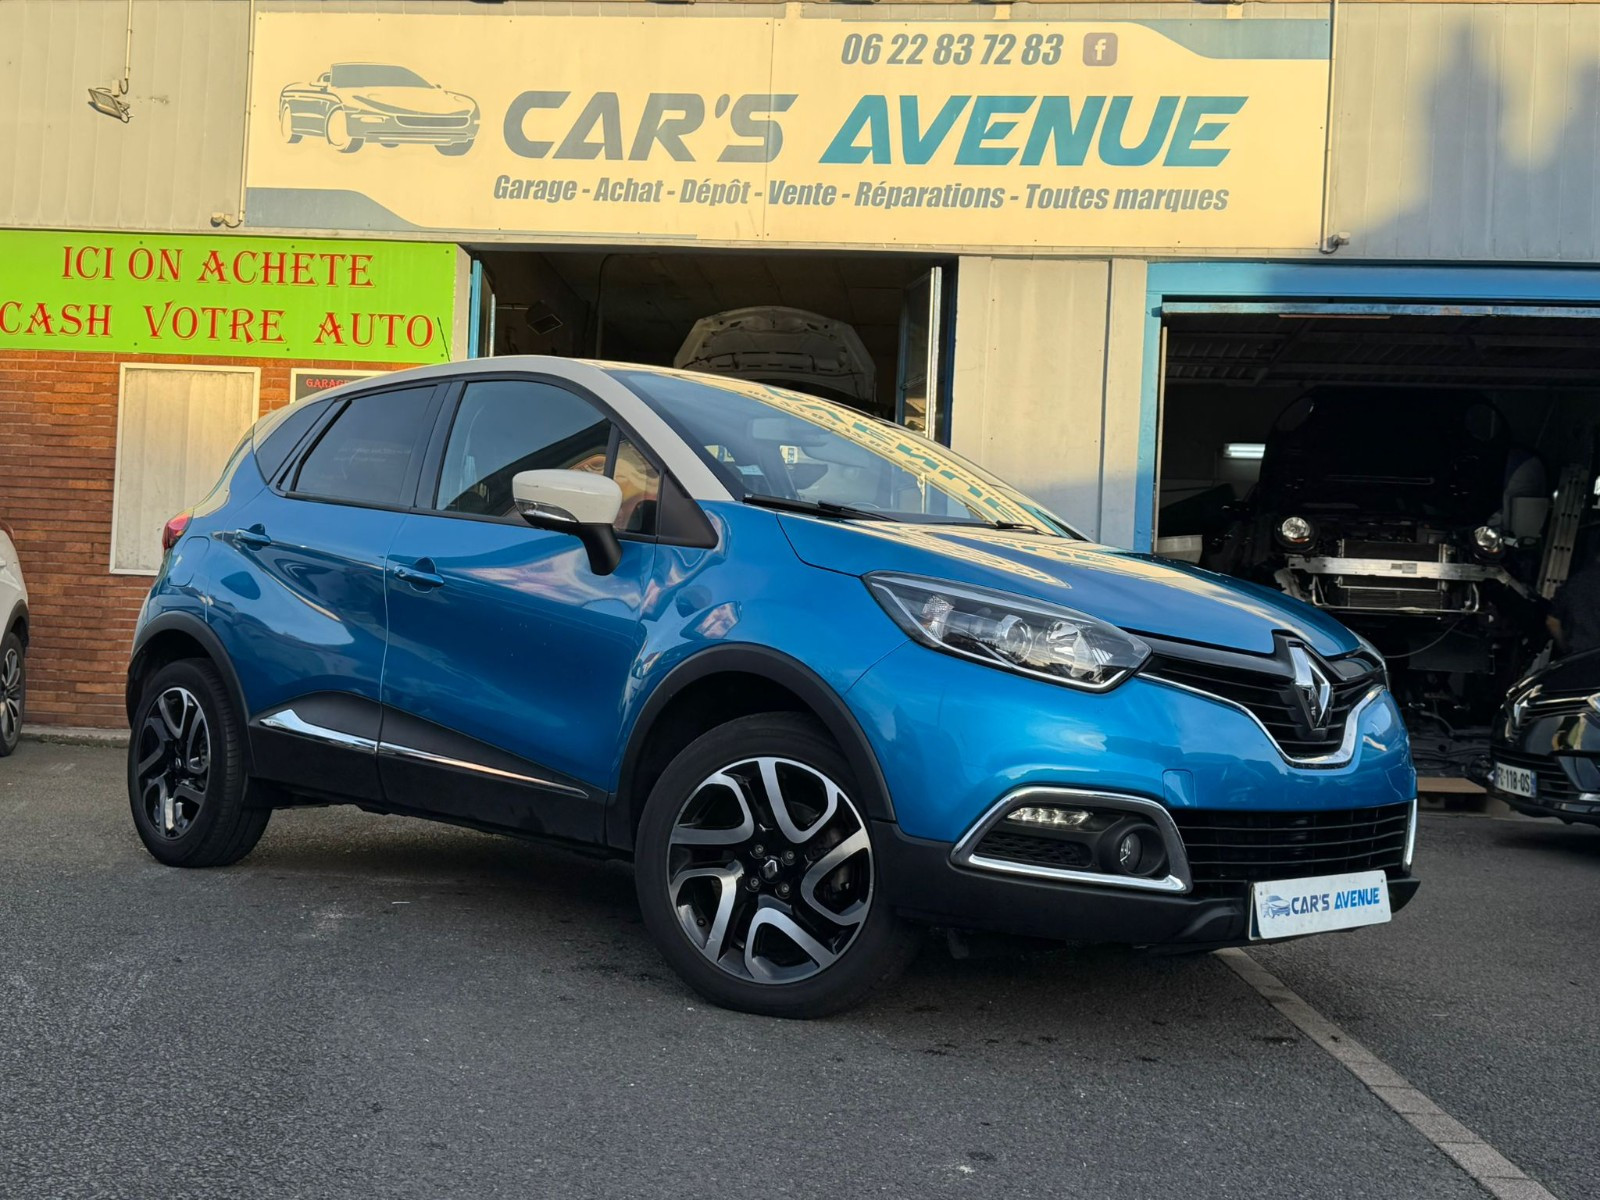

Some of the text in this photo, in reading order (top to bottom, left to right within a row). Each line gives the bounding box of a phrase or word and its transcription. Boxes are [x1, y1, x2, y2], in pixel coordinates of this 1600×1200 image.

[841, 33, 1065, 66] 06 22 83 72 83
[503, 90, 1250, 168] CAR'S AVENUE
[493, 174, 578, 204] Garage
[593, 177, 664, 203] Achat
[679, 178, 752, 207] Dépôt
[768, 180, 838, 206] Vente
[854, 180, 1006, 210] Réparations
[1025, 183, 1110, 210] Toutes
[1112, 188, 1230, 213] marques
[63, 246, 375, 288] ICI ON ACHETE
[0, 301, 436, 349] CASH VOTRE AUTO
[1291, 887, 1380, 915] CAR'S AVENUE
